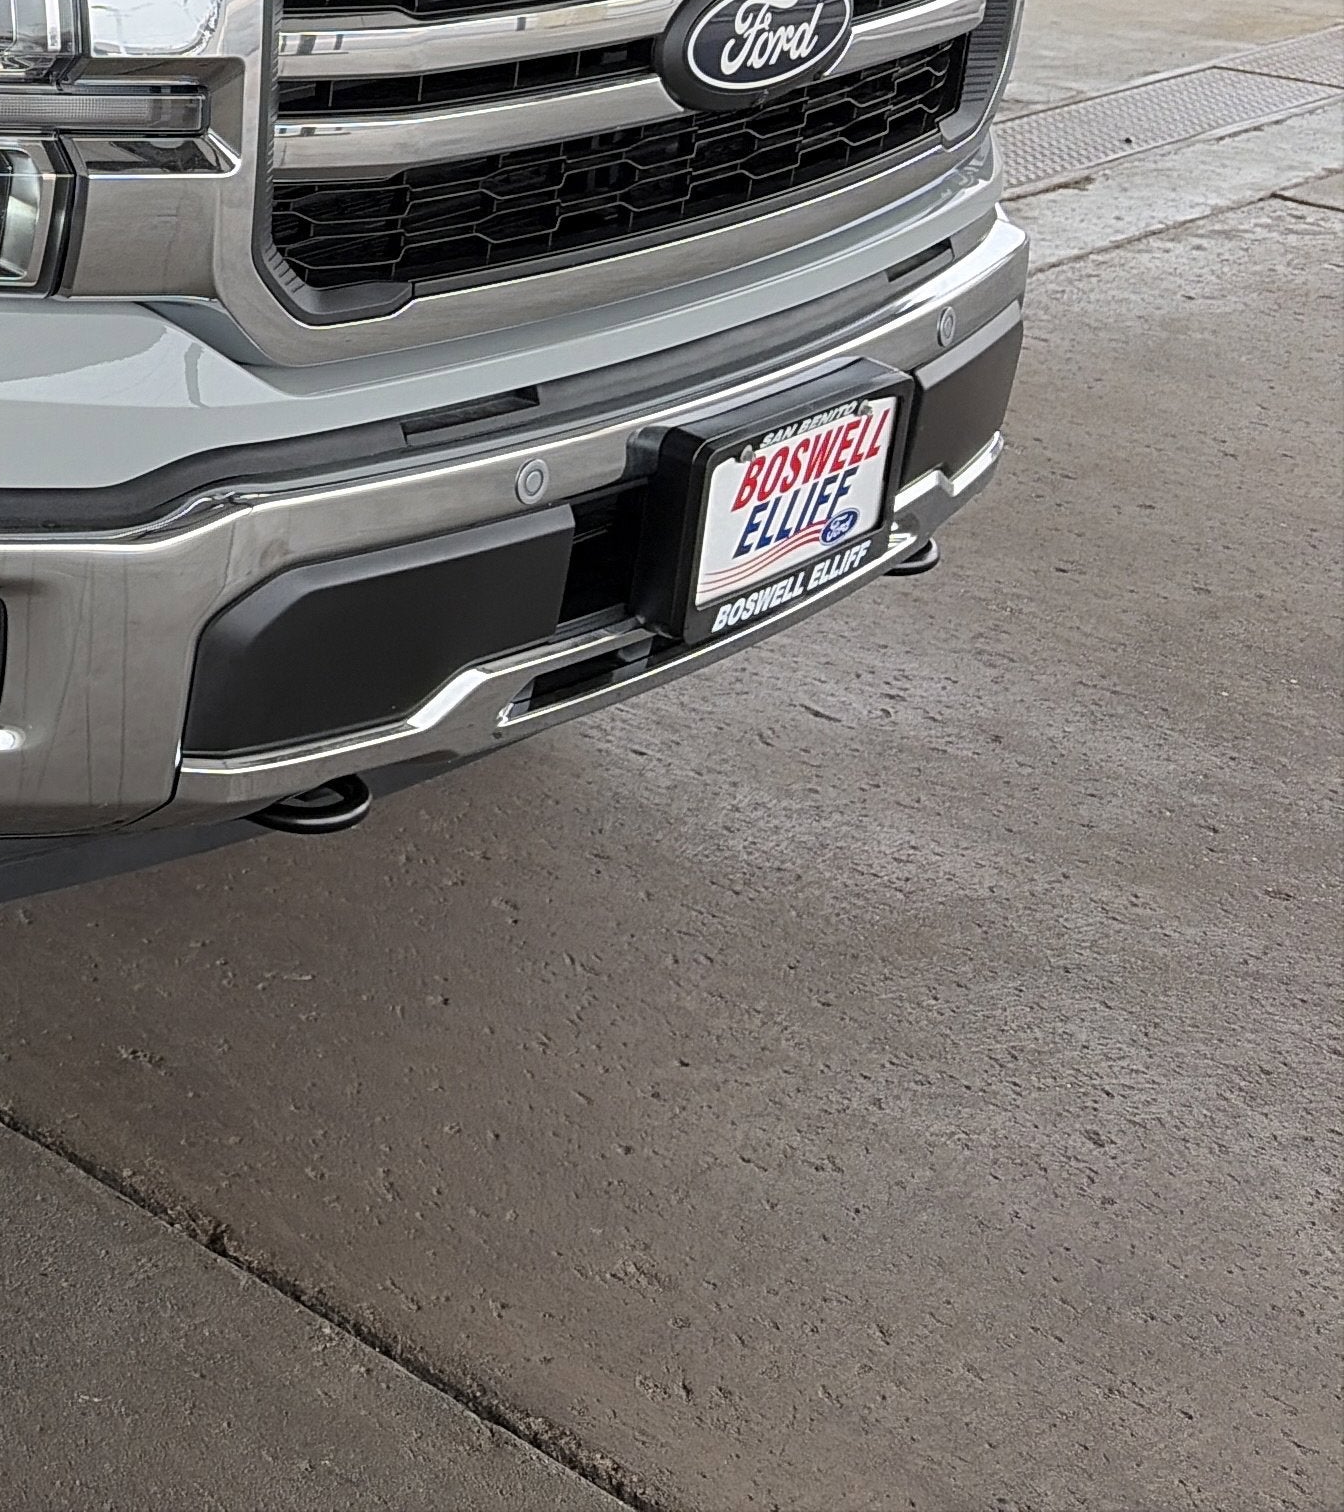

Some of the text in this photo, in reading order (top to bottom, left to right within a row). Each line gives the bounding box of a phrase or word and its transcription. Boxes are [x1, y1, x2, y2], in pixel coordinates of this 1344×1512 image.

[731, 408, 891, 512] BOSWELL
[760, 400, 858, 449] SAN BENITO
[732, 466, 859, 559] ELLIFF
[712, 540, 872, 632] BOSWELL ELLIFF
